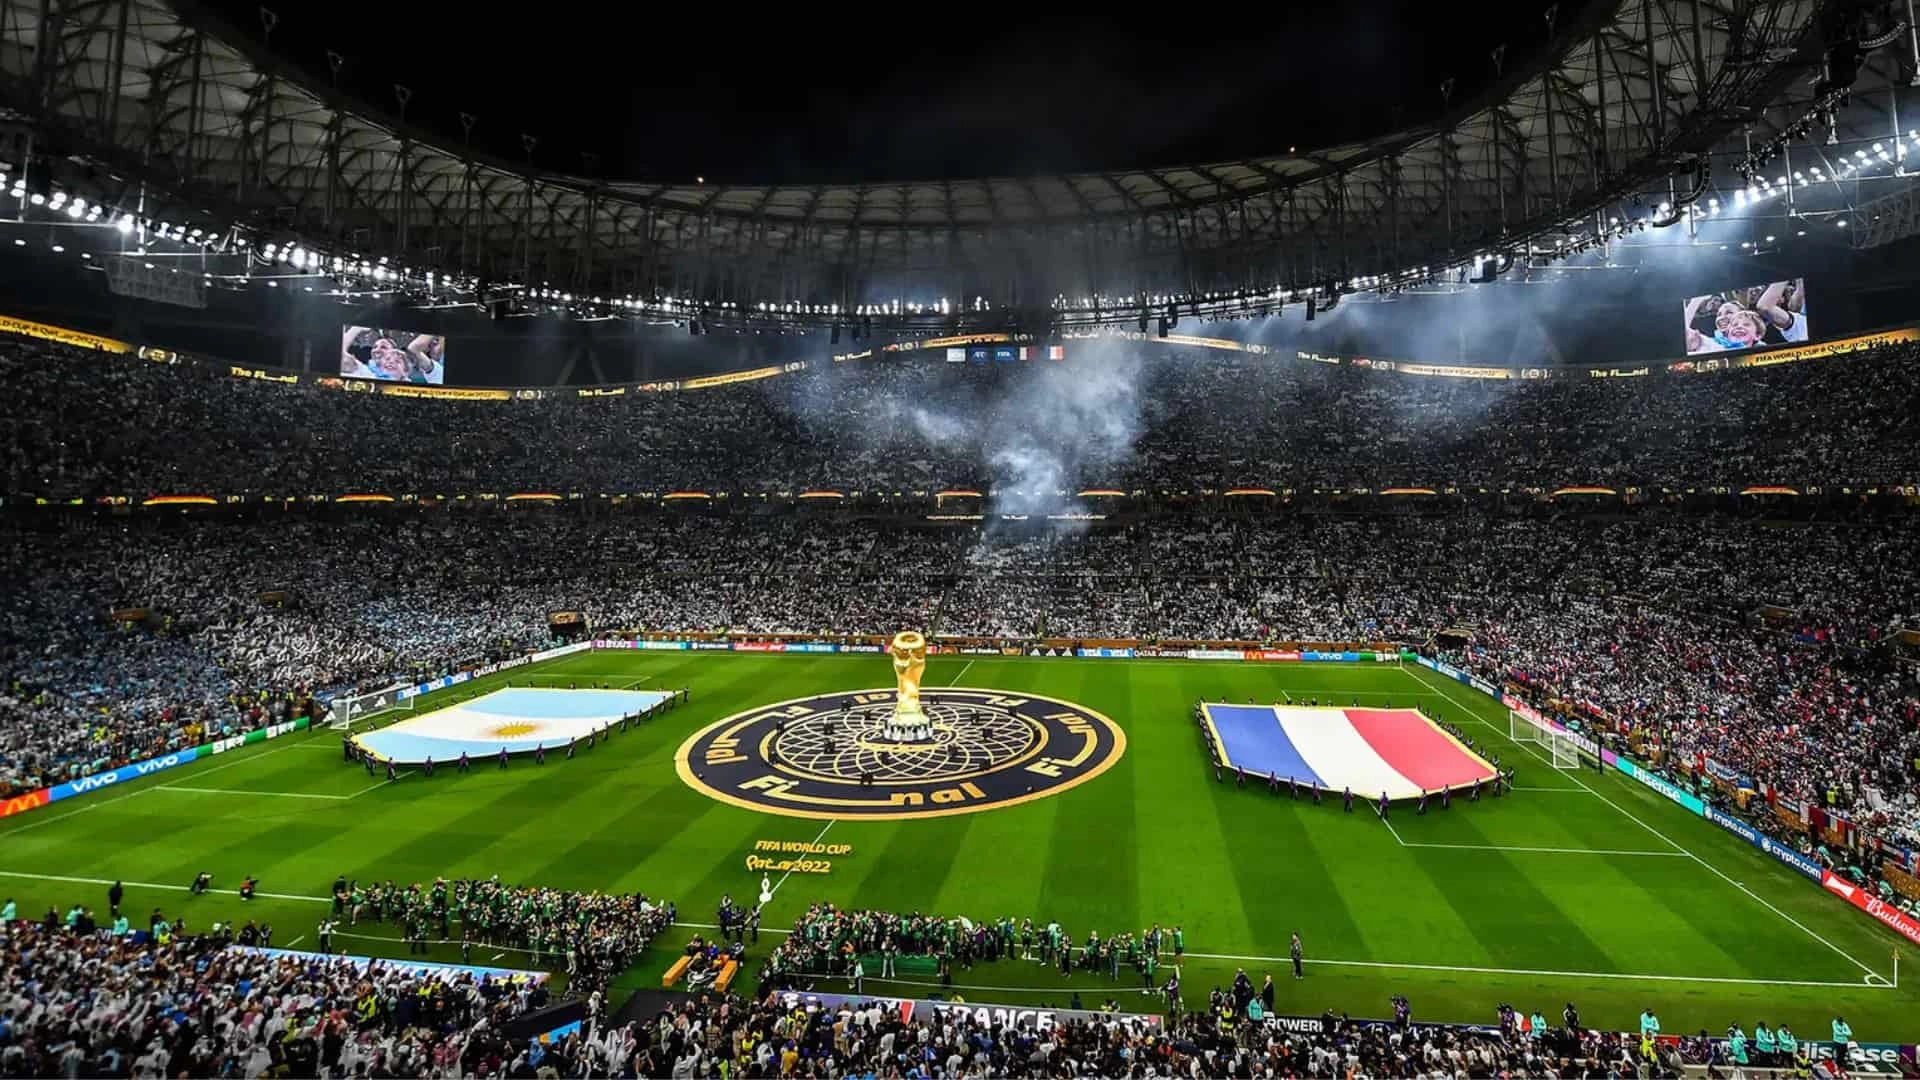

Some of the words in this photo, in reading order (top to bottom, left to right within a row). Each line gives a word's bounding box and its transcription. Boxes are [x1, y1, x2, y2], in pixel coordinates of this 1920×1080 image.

[230, 366, 252, 377] The
[473, 664, 497, 678] QATAR
[137, 754, 178, 773] vivo
[72, 772, 118, 793] vivo
[1633, 764, 1681, 804] Hisense
[1713, 812, 1756, 842] crypto.com
[755, 840, 780, 852] FIFA
[782, 842, 826, 853] WORLD
[826, 844, 852, 855] CUP
[1772, 845, 1822, 880] crypto.com
[1863, 892, 1920, 943] Budwei
